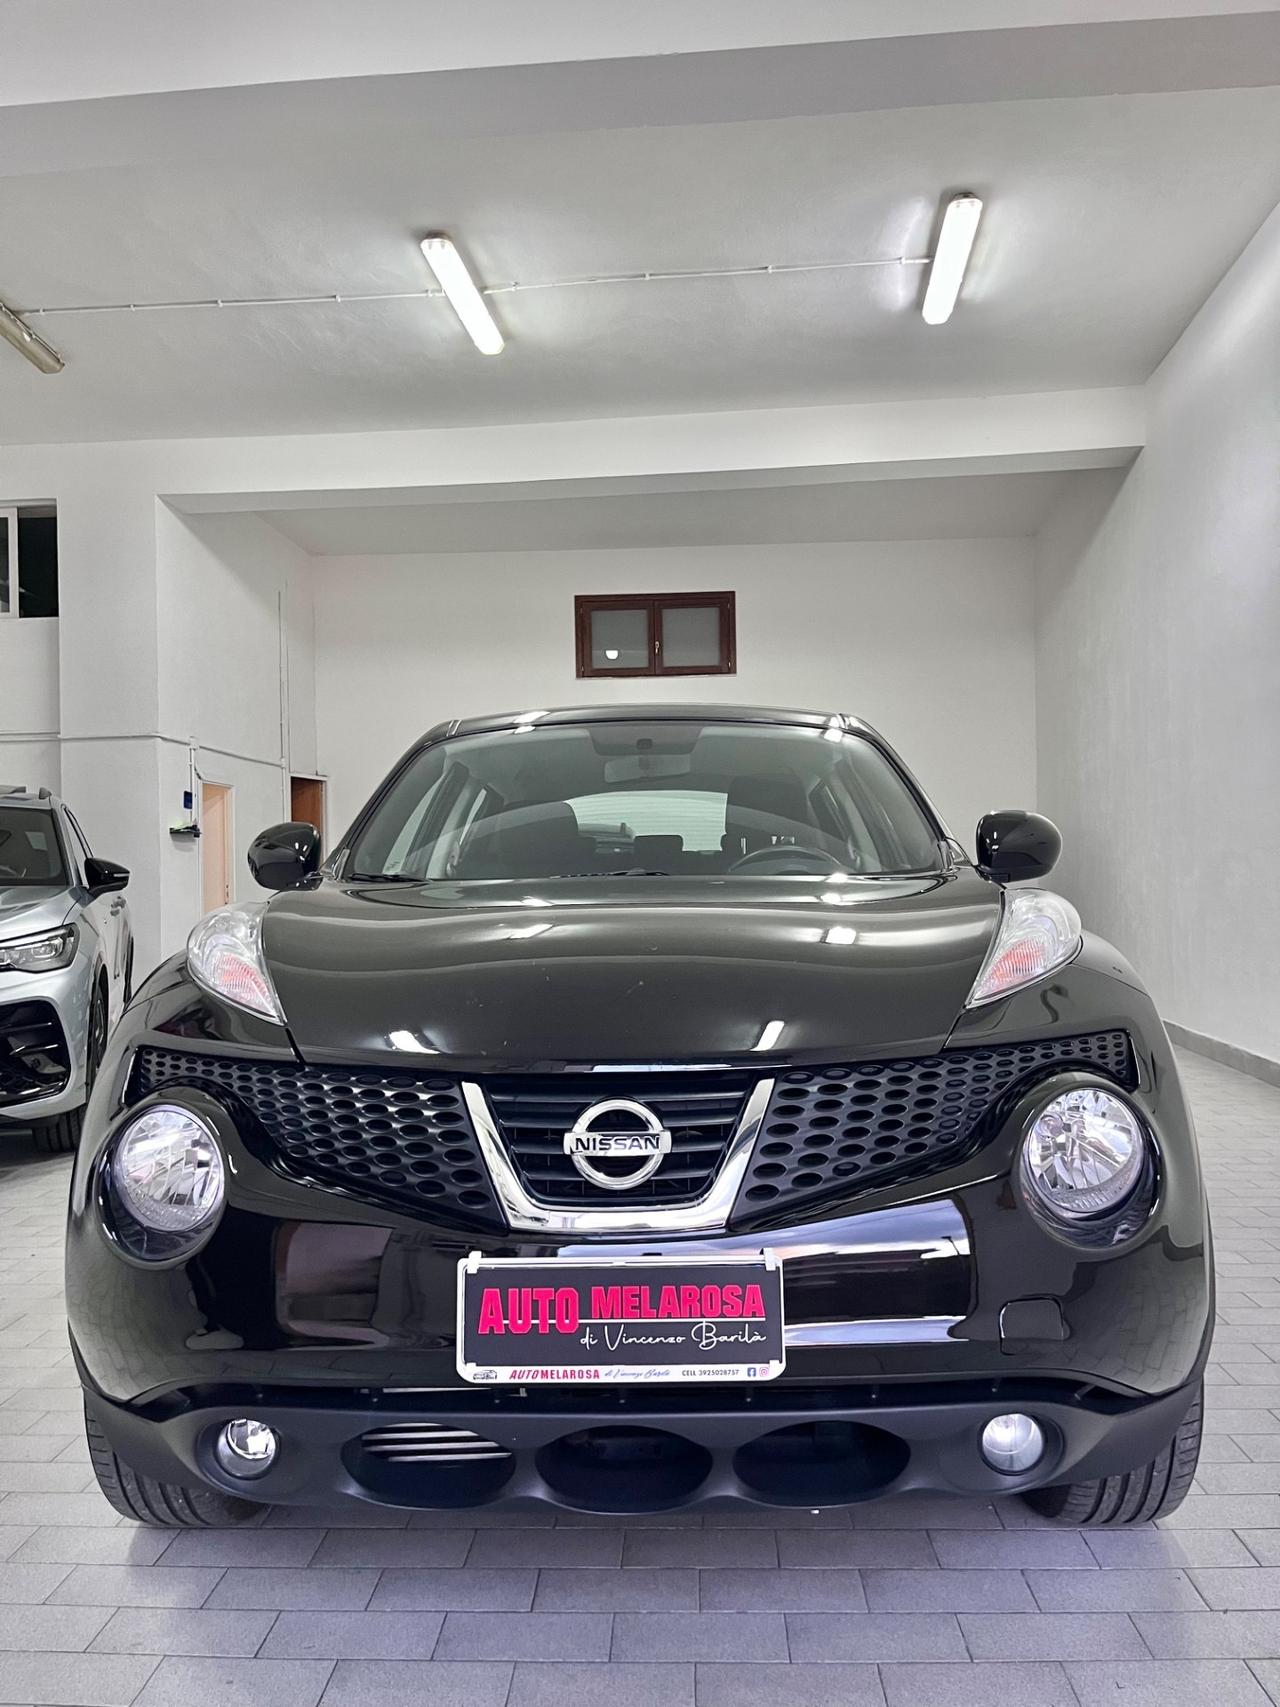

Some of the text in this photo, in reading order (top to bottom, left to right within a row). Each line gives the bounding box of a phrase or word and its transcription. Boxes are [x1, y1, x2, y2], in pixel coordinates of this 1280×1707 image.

[575, 1136, 661, 1151] NISSAN
[478, 1284, 766, 1334] AUTO MELAROSA
[580, 1320, 767, 1351] di Vincenzo Barilà
[681, 1369, 697, 1377] CELL
